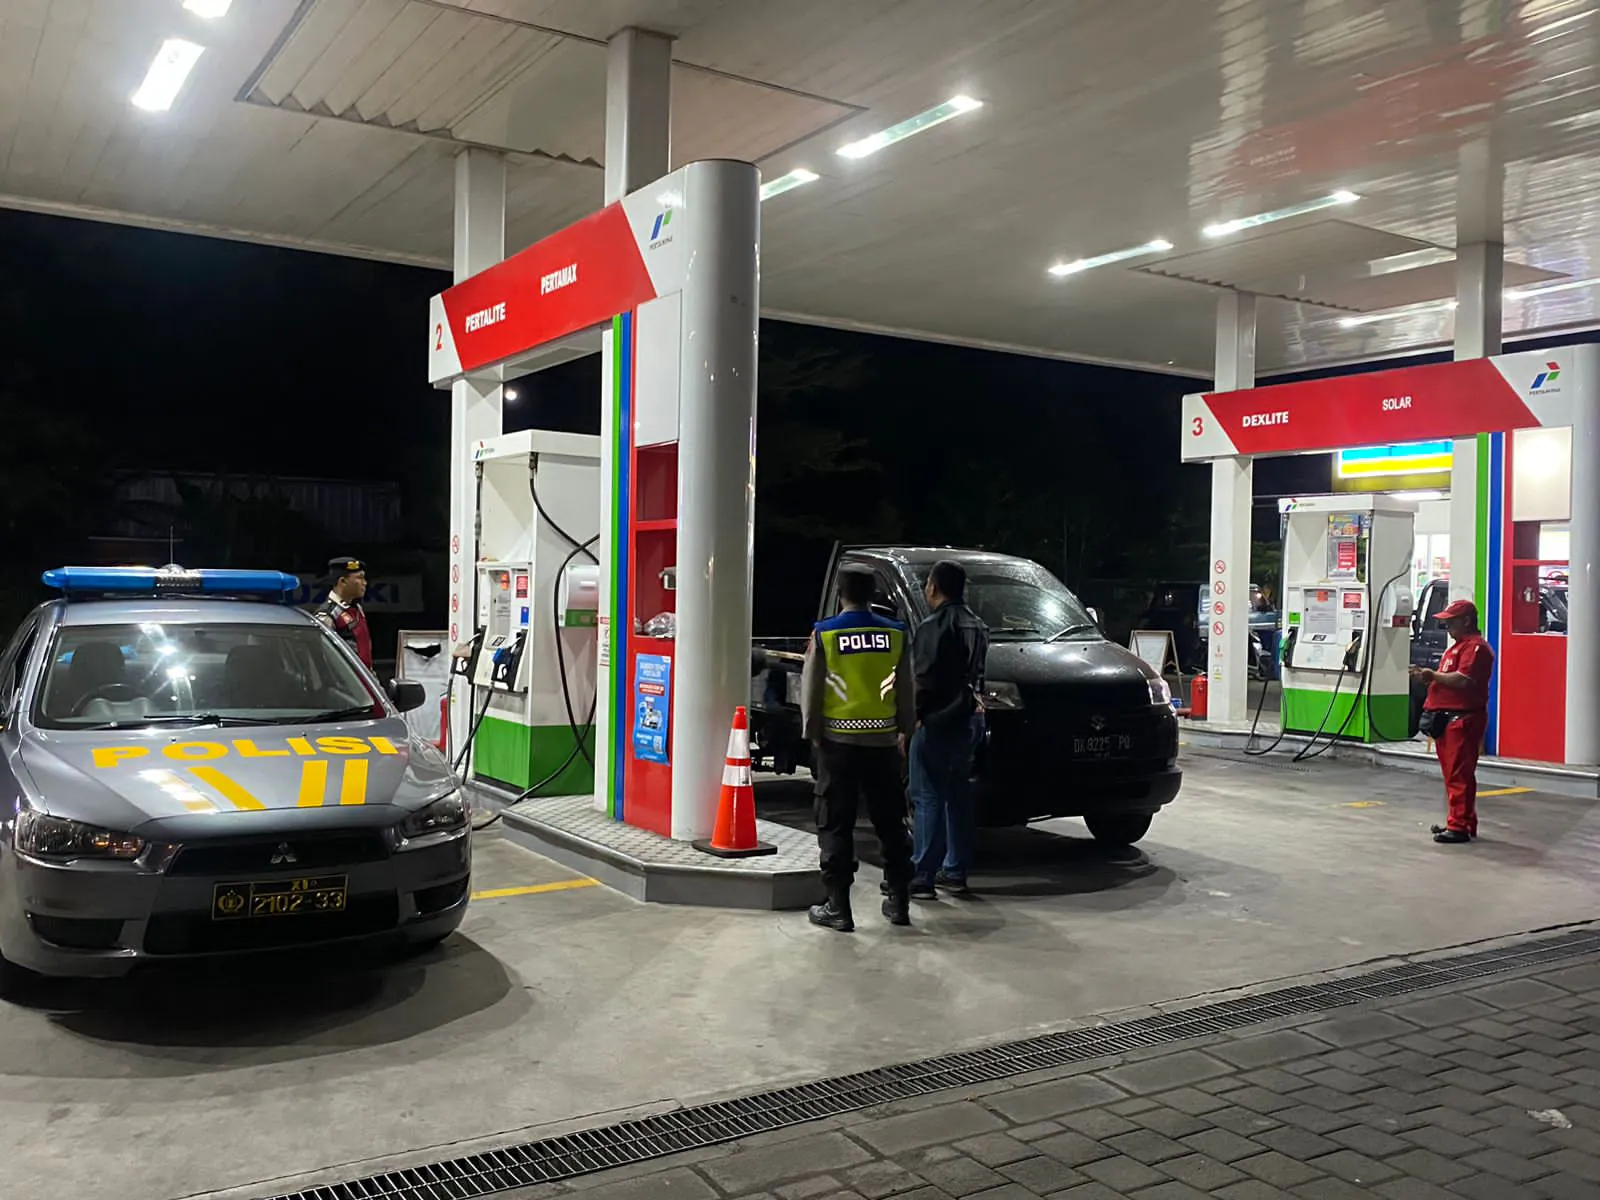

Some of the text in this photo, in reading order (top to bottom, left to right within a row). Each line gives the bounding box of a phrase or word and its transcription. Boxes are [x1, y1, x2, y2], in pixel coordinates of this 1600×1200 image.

[540, 263, 577, 296] PERTAMAX
[465, 302, 506, 333] PERTALITE
[435, 323, 443, 351] 2
[1382, 396, 1412, 412] SOLAR
[1192, 417, 1204, 436] 3
[1242, 411, 1289, 428] DEXLITE
[839, 634, 890, 651] POLISI
[91, 736, 399, 769] POLISI
